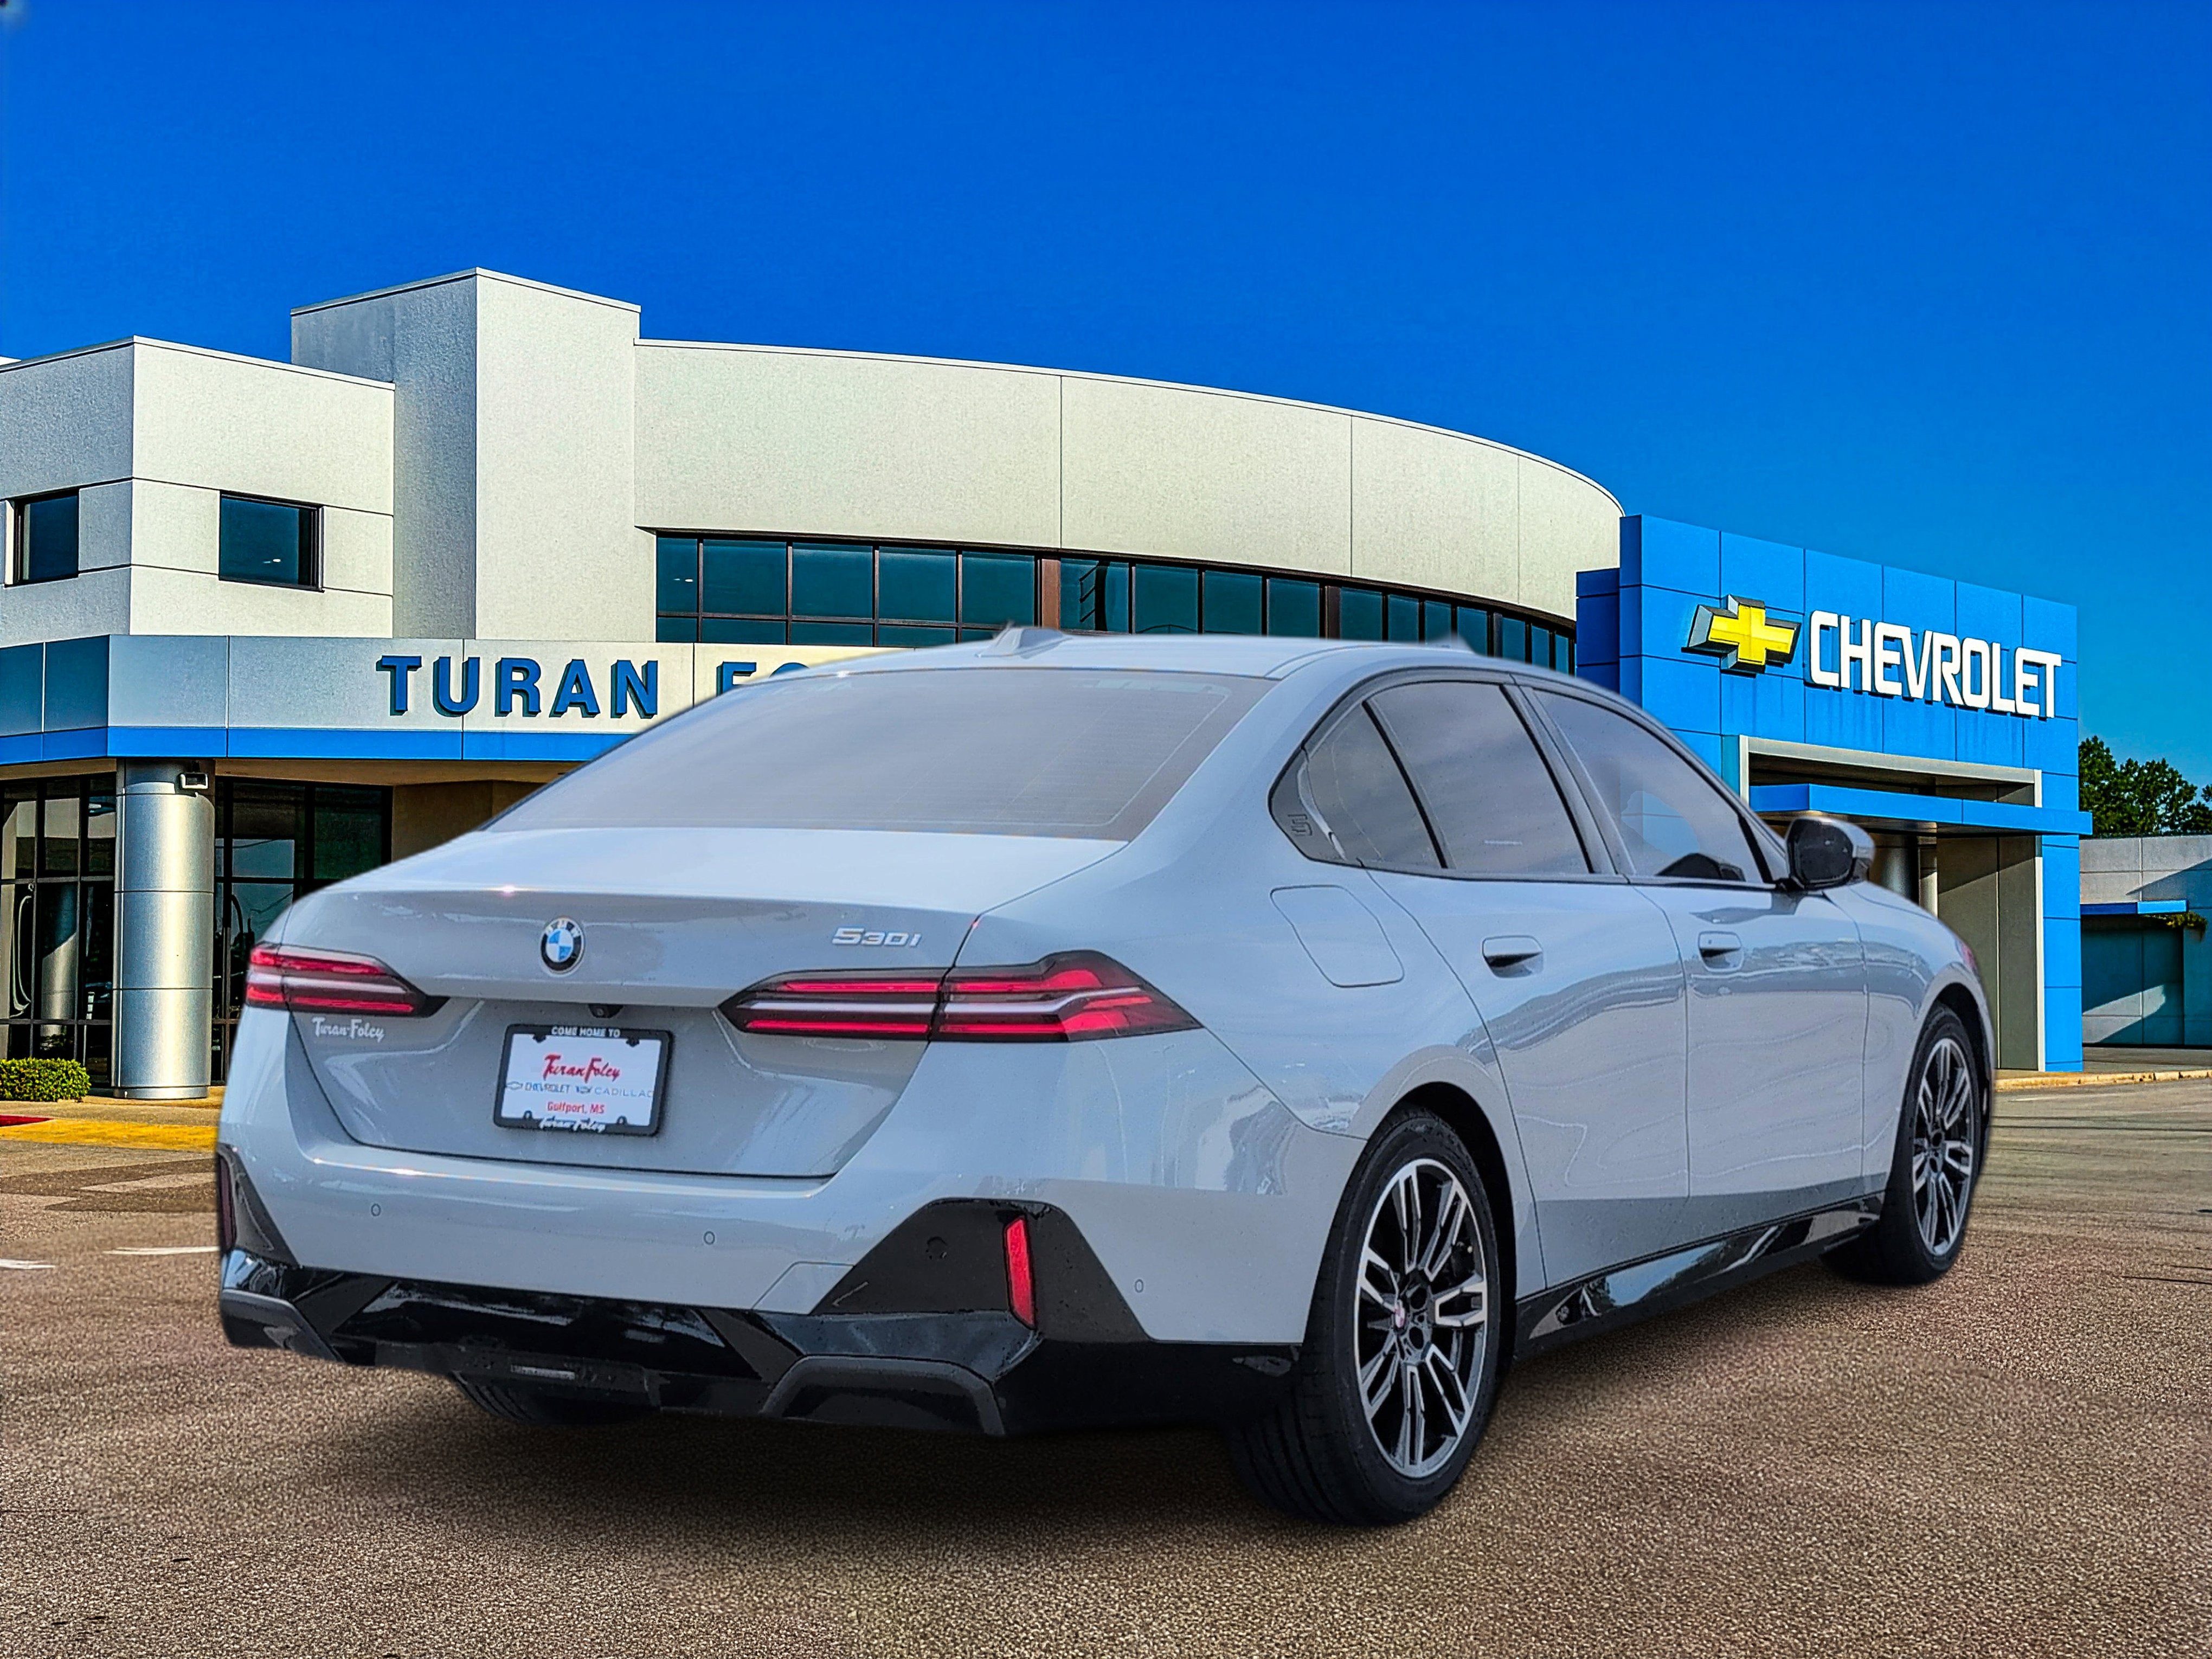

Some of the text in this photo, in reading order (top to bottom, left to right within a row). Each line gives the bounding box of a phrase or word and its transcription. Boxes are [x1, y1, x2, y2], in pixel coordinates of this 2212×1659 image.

[1807, 609, 2062, 718] CHEVROLET
[376, 654, 659, 718] TURAN
[551, 1026, 621, 1038] COME HOME TO
[590, 1104, 605, 1114] MS
